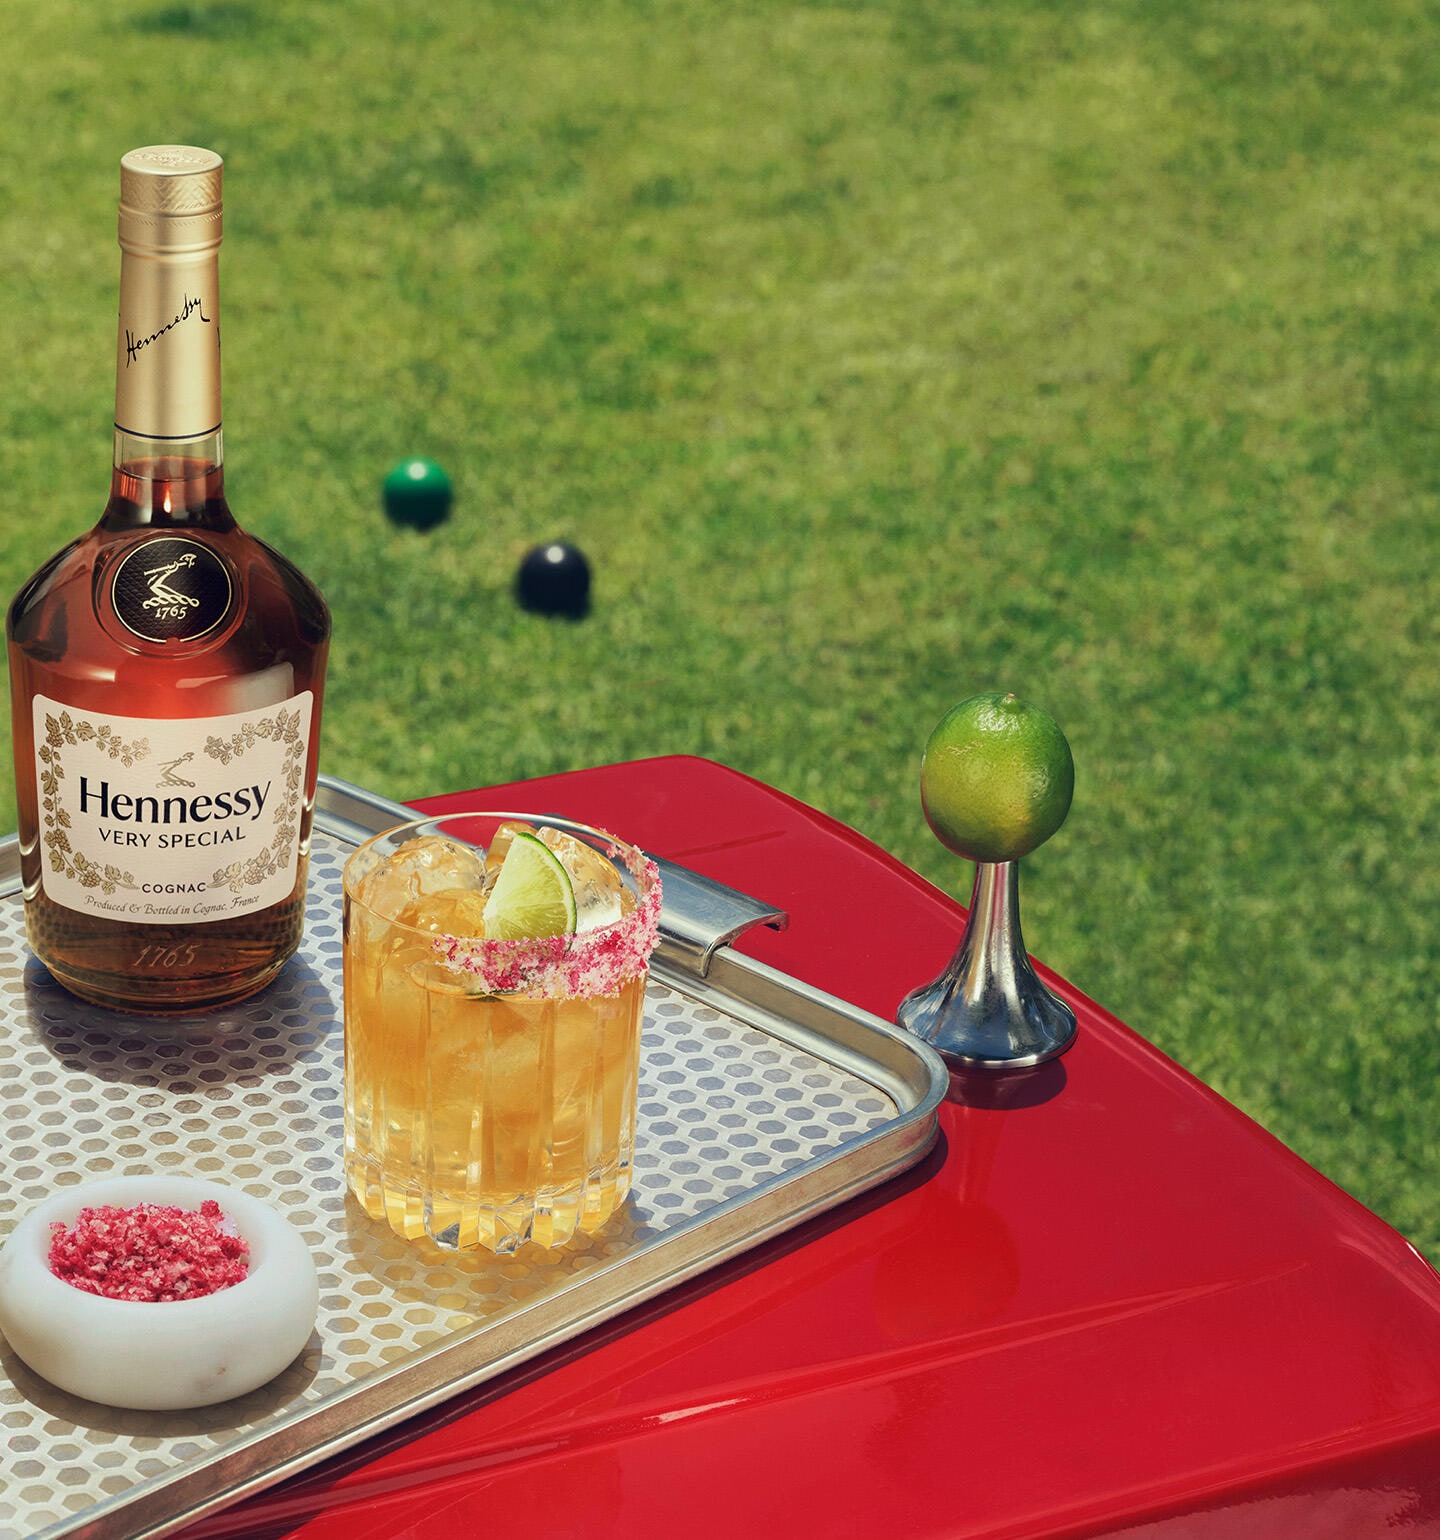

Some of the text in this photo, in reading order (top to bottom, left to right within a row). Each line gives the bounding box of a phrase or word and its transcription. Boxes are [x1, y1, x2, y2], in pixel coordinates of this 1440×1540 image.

[155, 605, 188, 620] 1765
[80, 776, 271, 824] Hennessy
[99, 826, 246, 848] VERY SPECIAL
[141, 882, 207, 894] COGNAC
[84, 895, 126, 912] Produced
[129, 904, 142, 913] &
[144, 904, 178, 915] Bottled
[180, 905, 190, 914] in
[231, 894, 260, 910] France
[131, 944, 202, 968] 1765
